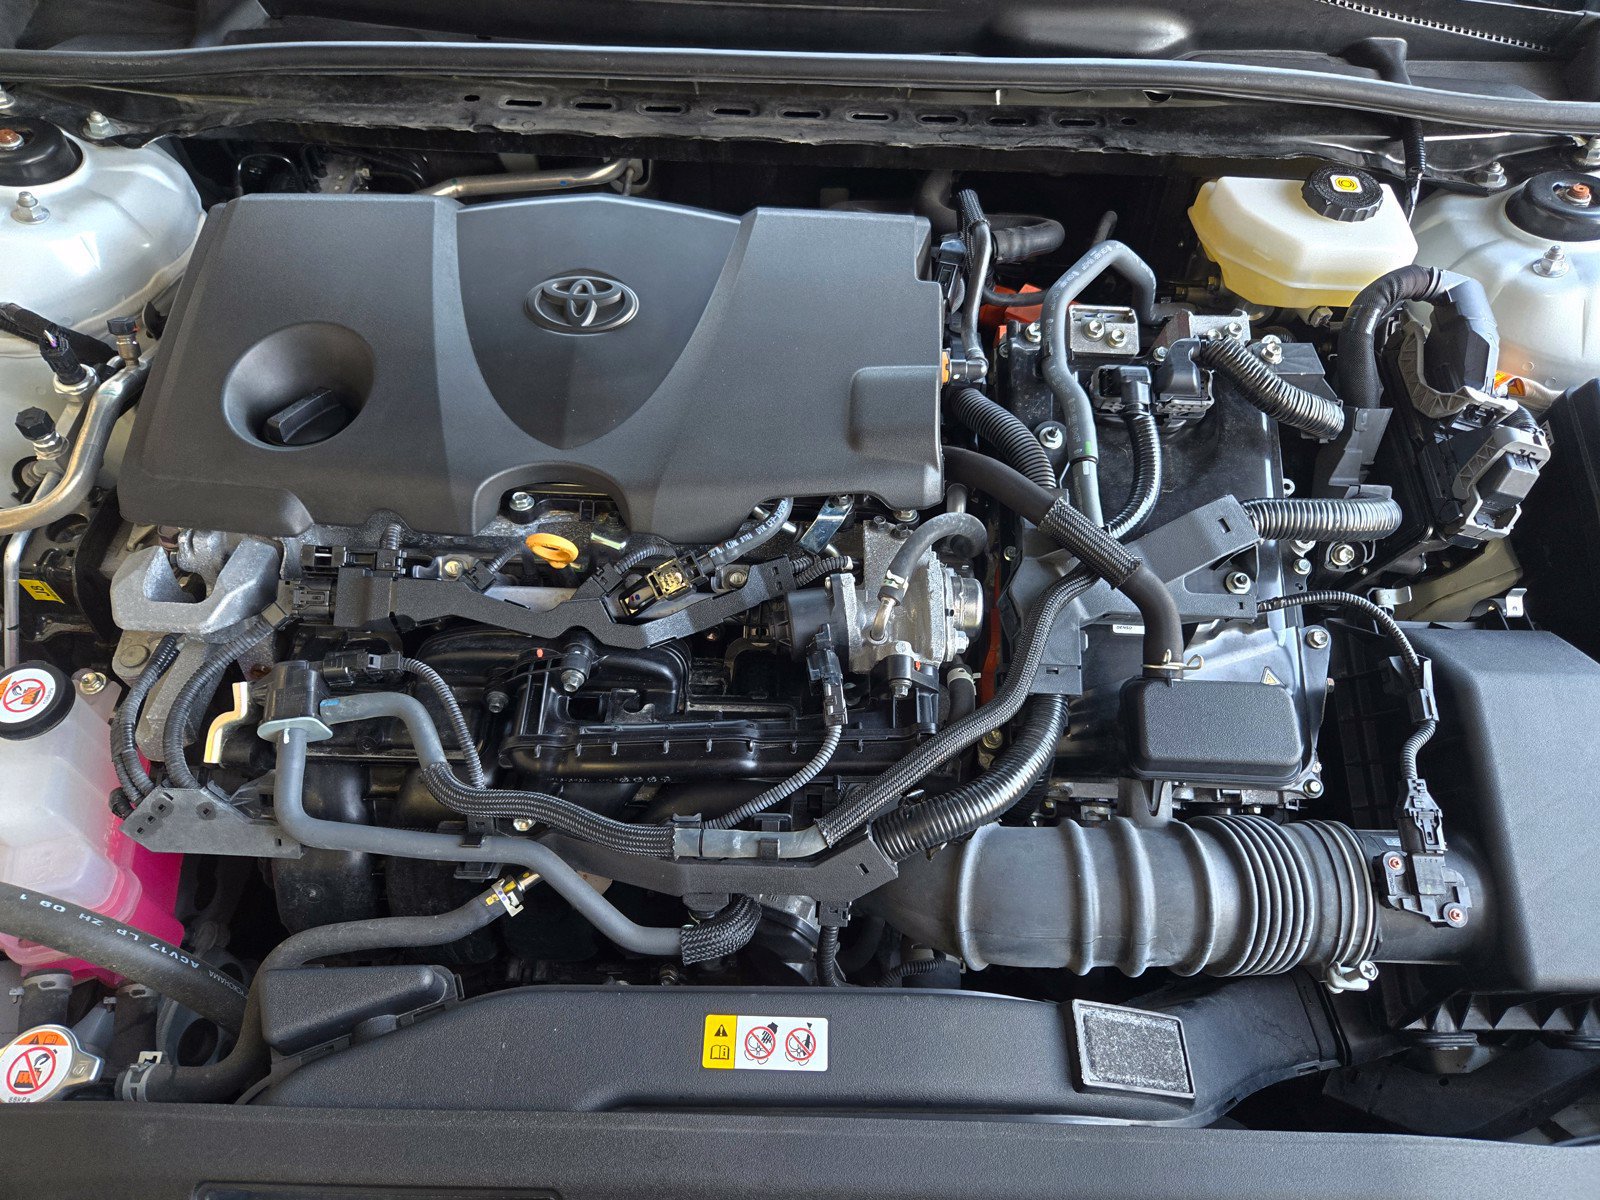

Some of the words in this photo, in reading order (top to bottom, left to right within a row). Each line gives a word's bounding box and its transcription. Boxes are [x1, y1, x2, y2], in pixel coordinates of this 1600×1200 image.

[39, 900, 66, 913] 09
[79, 913, 103, 926] ZH
[116, 928, 139, 941] LP
[149, 942, 200, 969] ACV17
